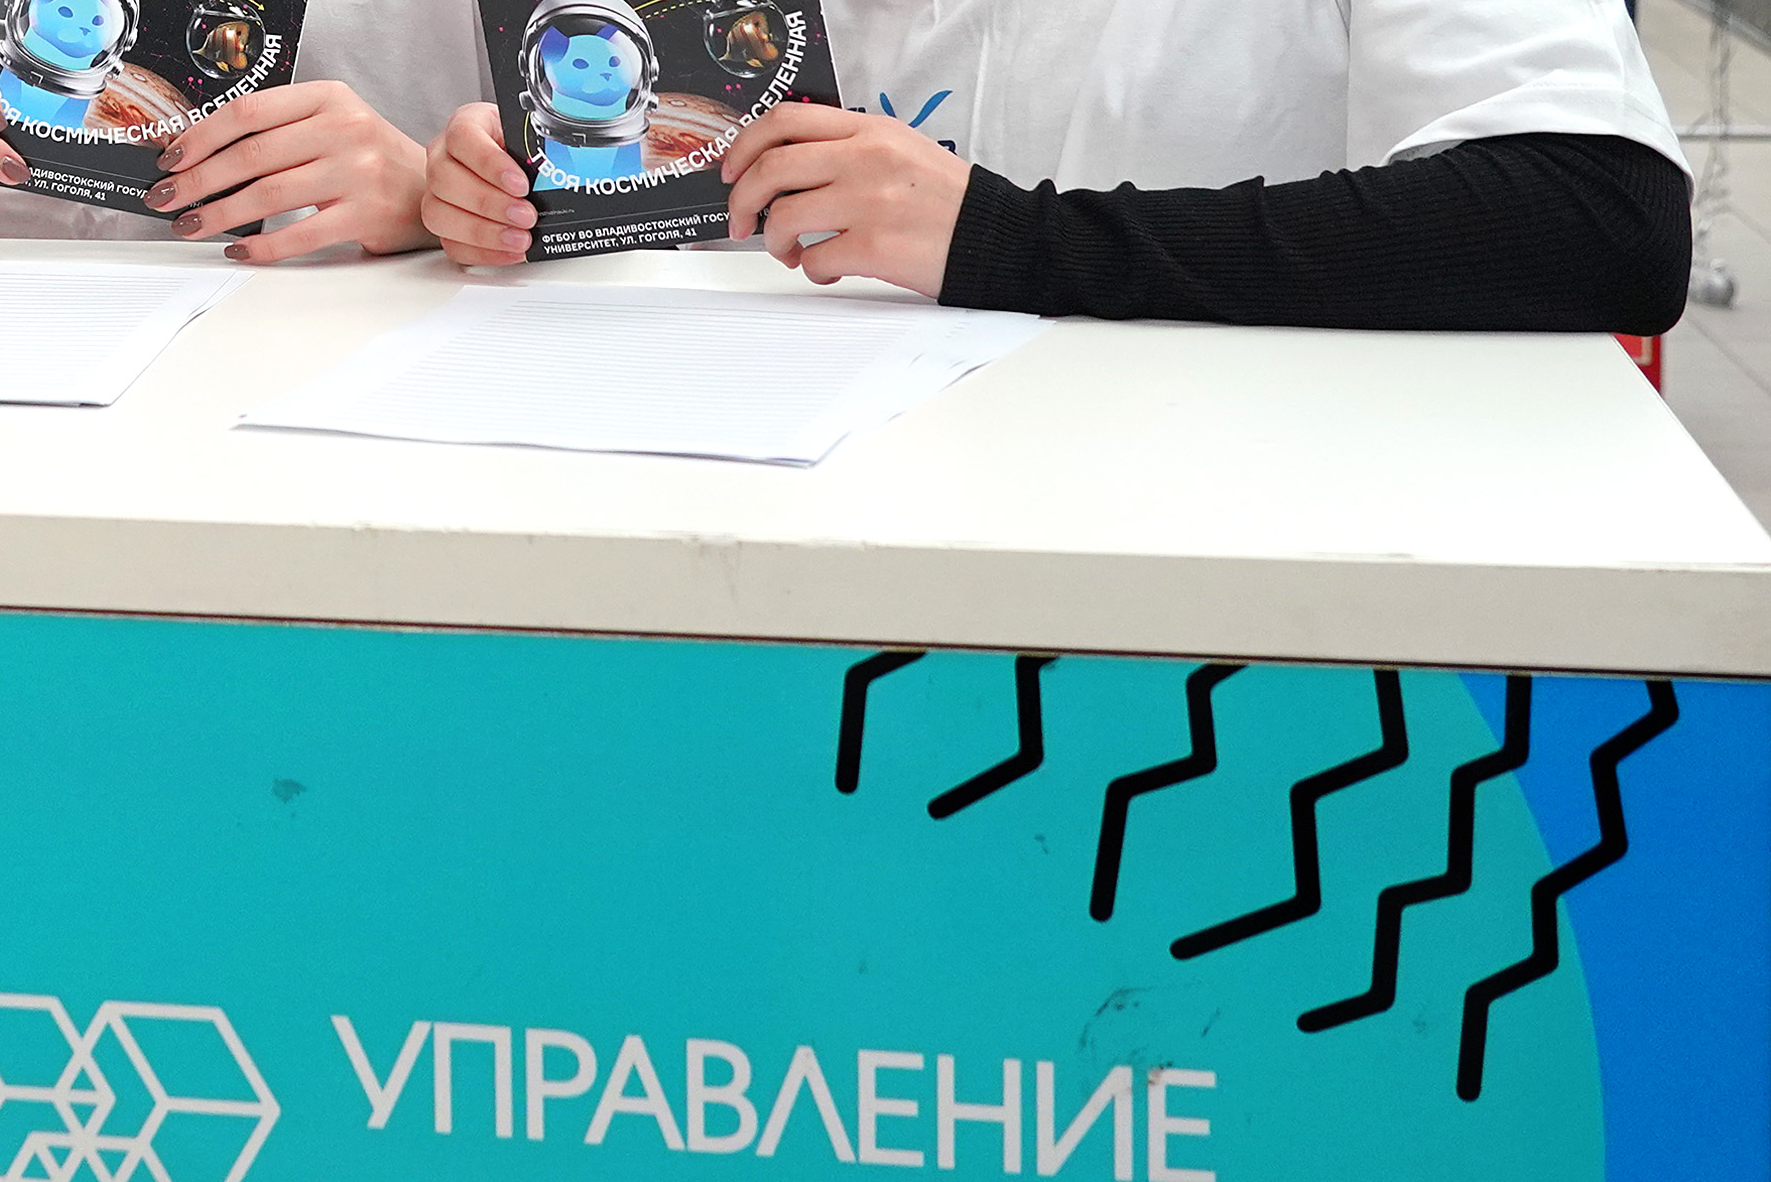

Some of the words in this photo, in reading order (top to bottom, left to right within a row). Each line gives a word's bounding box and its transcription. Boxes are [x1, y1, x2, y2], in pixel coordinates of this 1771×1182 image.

[21, 115, 184, 145] КОСМИЧЕСКАЯ
[531, 146, 581, 193] ТВОЯ
[585, 126, 739, 196] КОСМИЧЕСКАЯ
[34, 179, 49, 190] УЛ.
[51, 182, 93, 200] ГОГОЛЯ,
[95, 191, 106, 201] 41
[541, 232, 577, 244] ФГБОУ
[578, 229, 593, 240] ВО
[595, 215, 701, 237] ВЛАДИВОСТОКСКИЙ
[544, 237, 619, 255] УНИВЕРСИТЕТ,
[620, 233, 637, 246] УЛ.
[639, 229, 684, 244] ГОГОЛЯ,
[685, 227, 697, 237] 41
[332, 1013, 1217, 1182] УПРАВЛЕНИЕ
